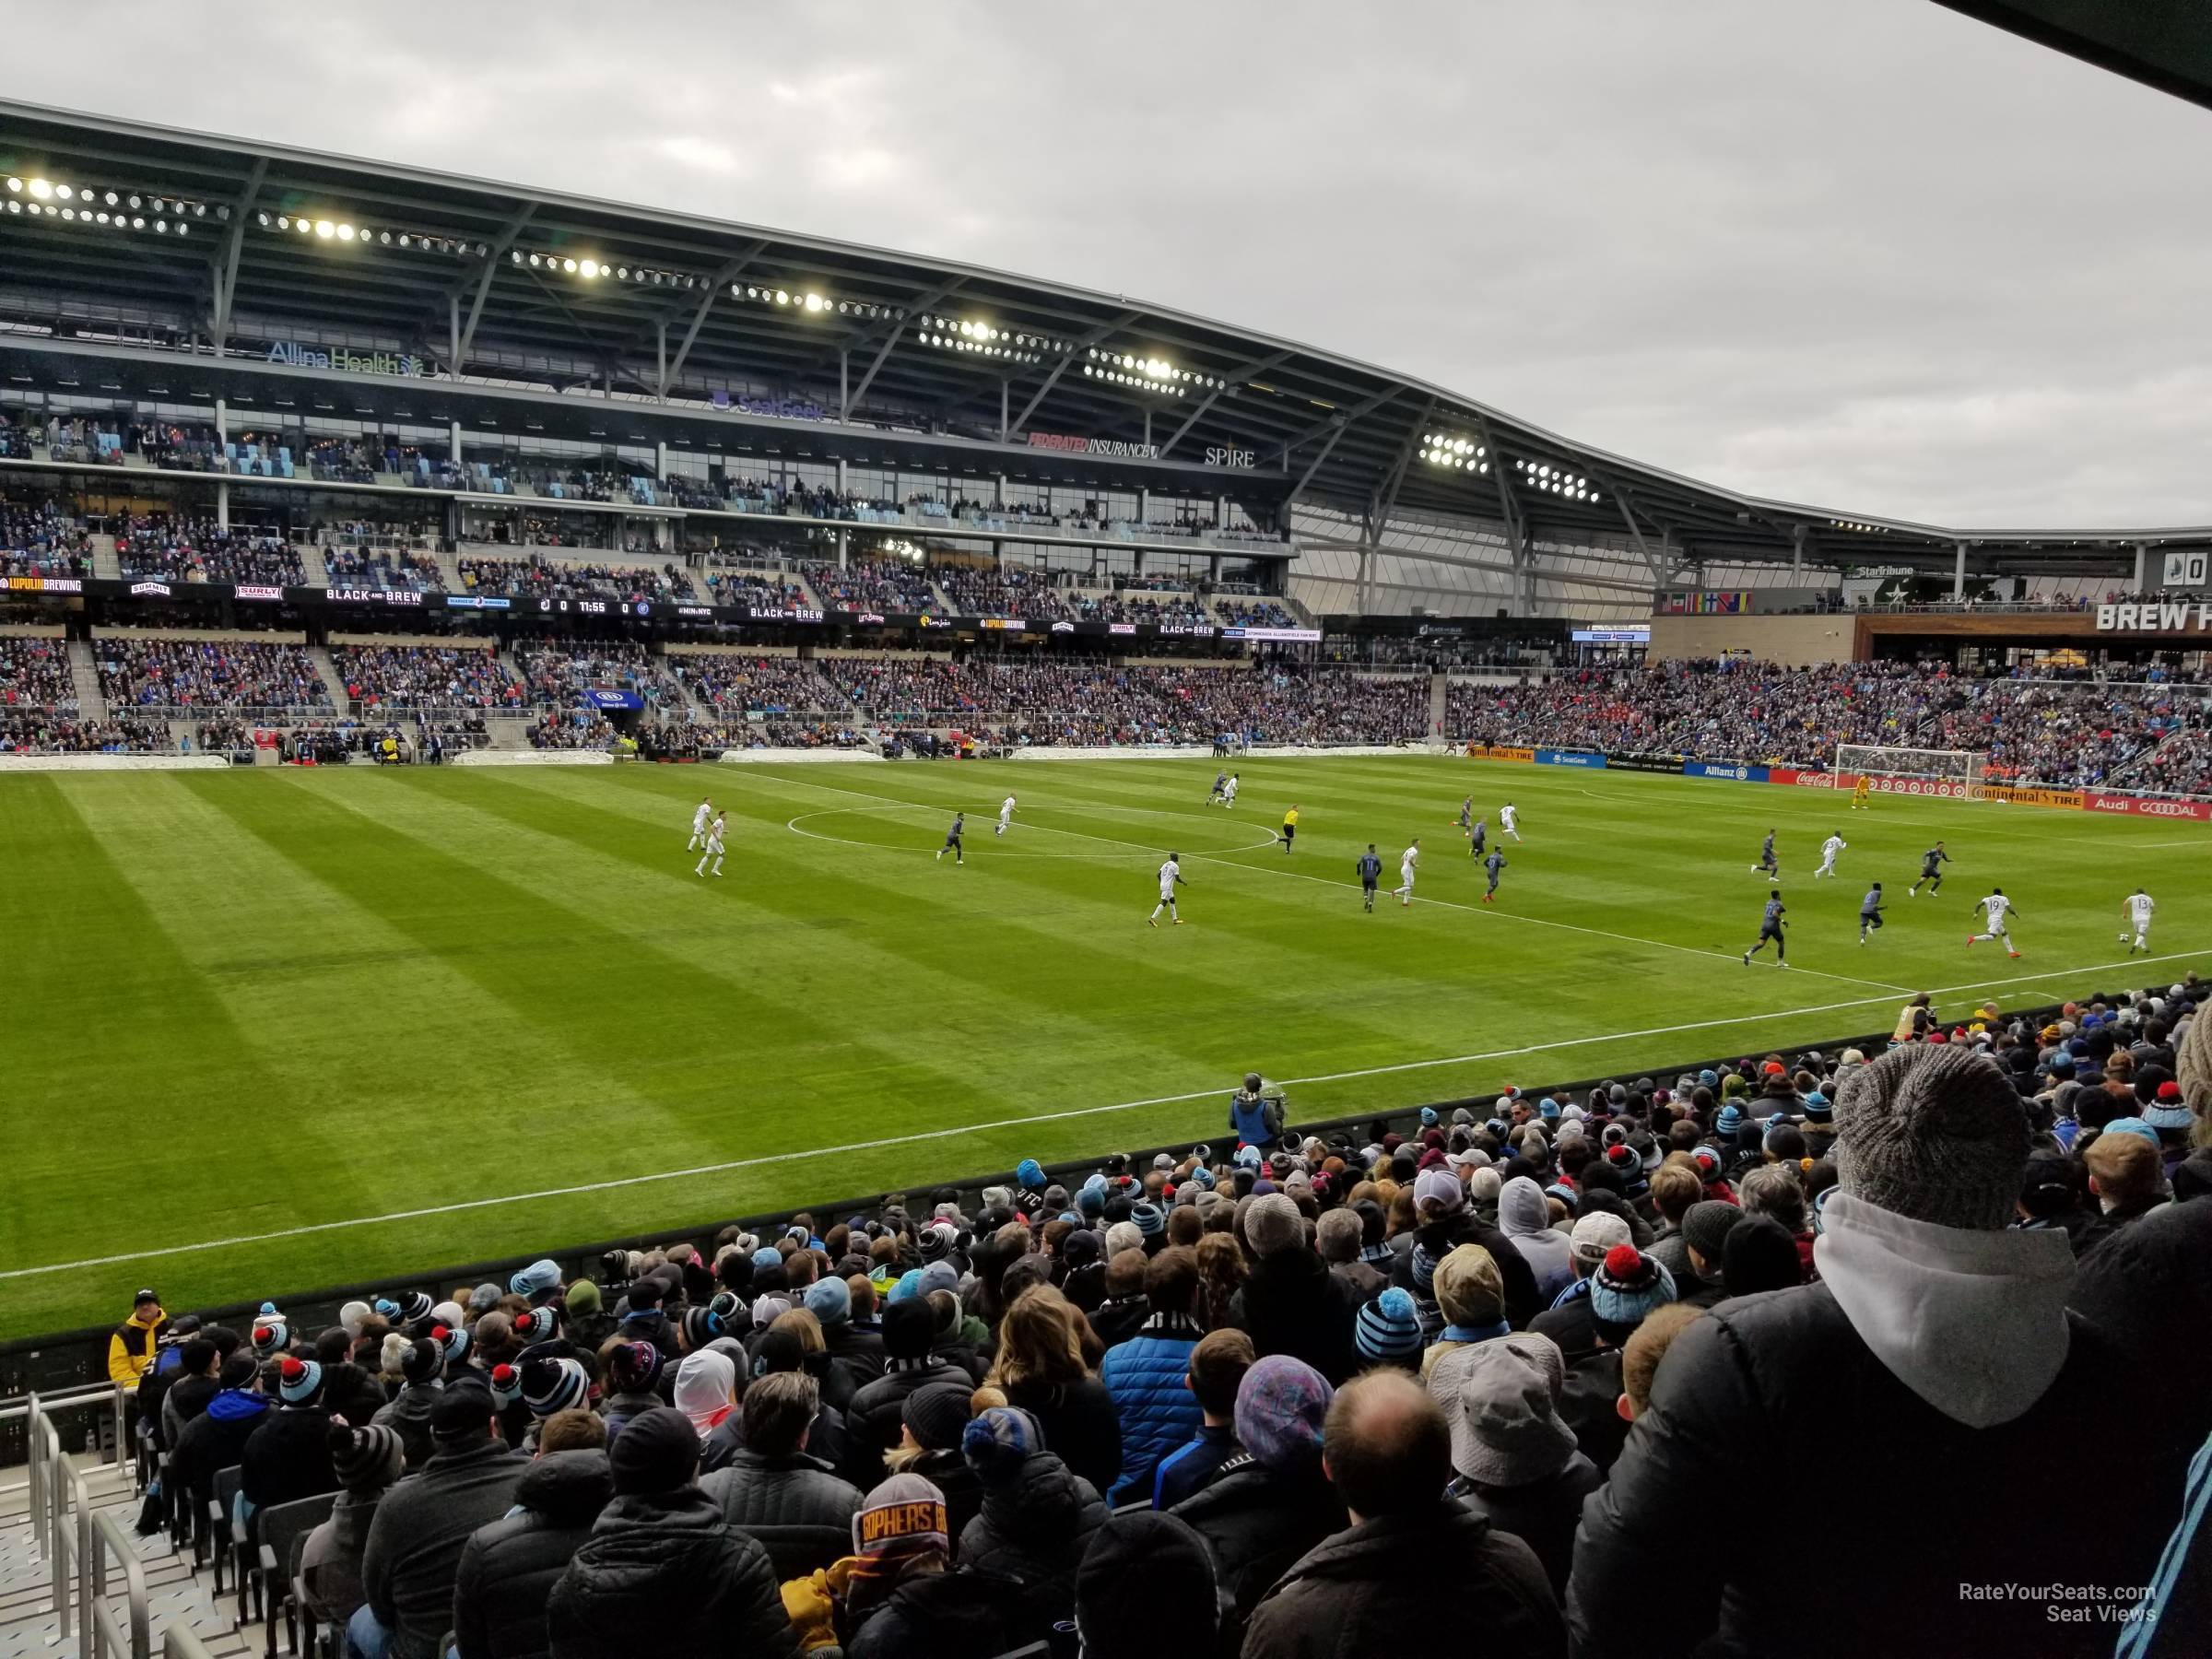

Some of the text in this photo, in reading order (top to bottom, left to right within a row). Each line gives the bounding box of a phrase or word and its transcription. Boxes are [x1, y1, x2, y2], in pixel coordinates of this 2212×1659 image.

[267, 342, 398, 374] Allina Health
[737, 394, 828, 421] SeatGeek
[1028, 432, 1150, 458] FEDERATED INSURANCE
[1204, 447, 1254, 468] SPIRE
[133, 583, 168, 593] SUMMIT
[326, 590, 369, 600] BLACK
[386, 592, 422, 602] BREW
[559, 600, 629, 613] 0 11:55 0
[750, 608, 783, 618] BLACK
[795, 610, 823, 619] BREW
[2097, 604, 2189, 630] BREW
[1159, 625, 1184, 633] BLACK
[1194, 626, 1215, 635] BREW
[1562, 756, 1587, 764] SeatGeek
[1705, 766, 1735, 777] Allianz
[1971, 786, 2081, 806] Continental TIRE
[2094, 799, 2128, 810] Audi
[1367, 860, 1373, 871] 11
[1990, 900, 1999, 911] 19
[2138, 899, 2147, 910] 13
[863, 1503, 933, 1541] GOPHERS
